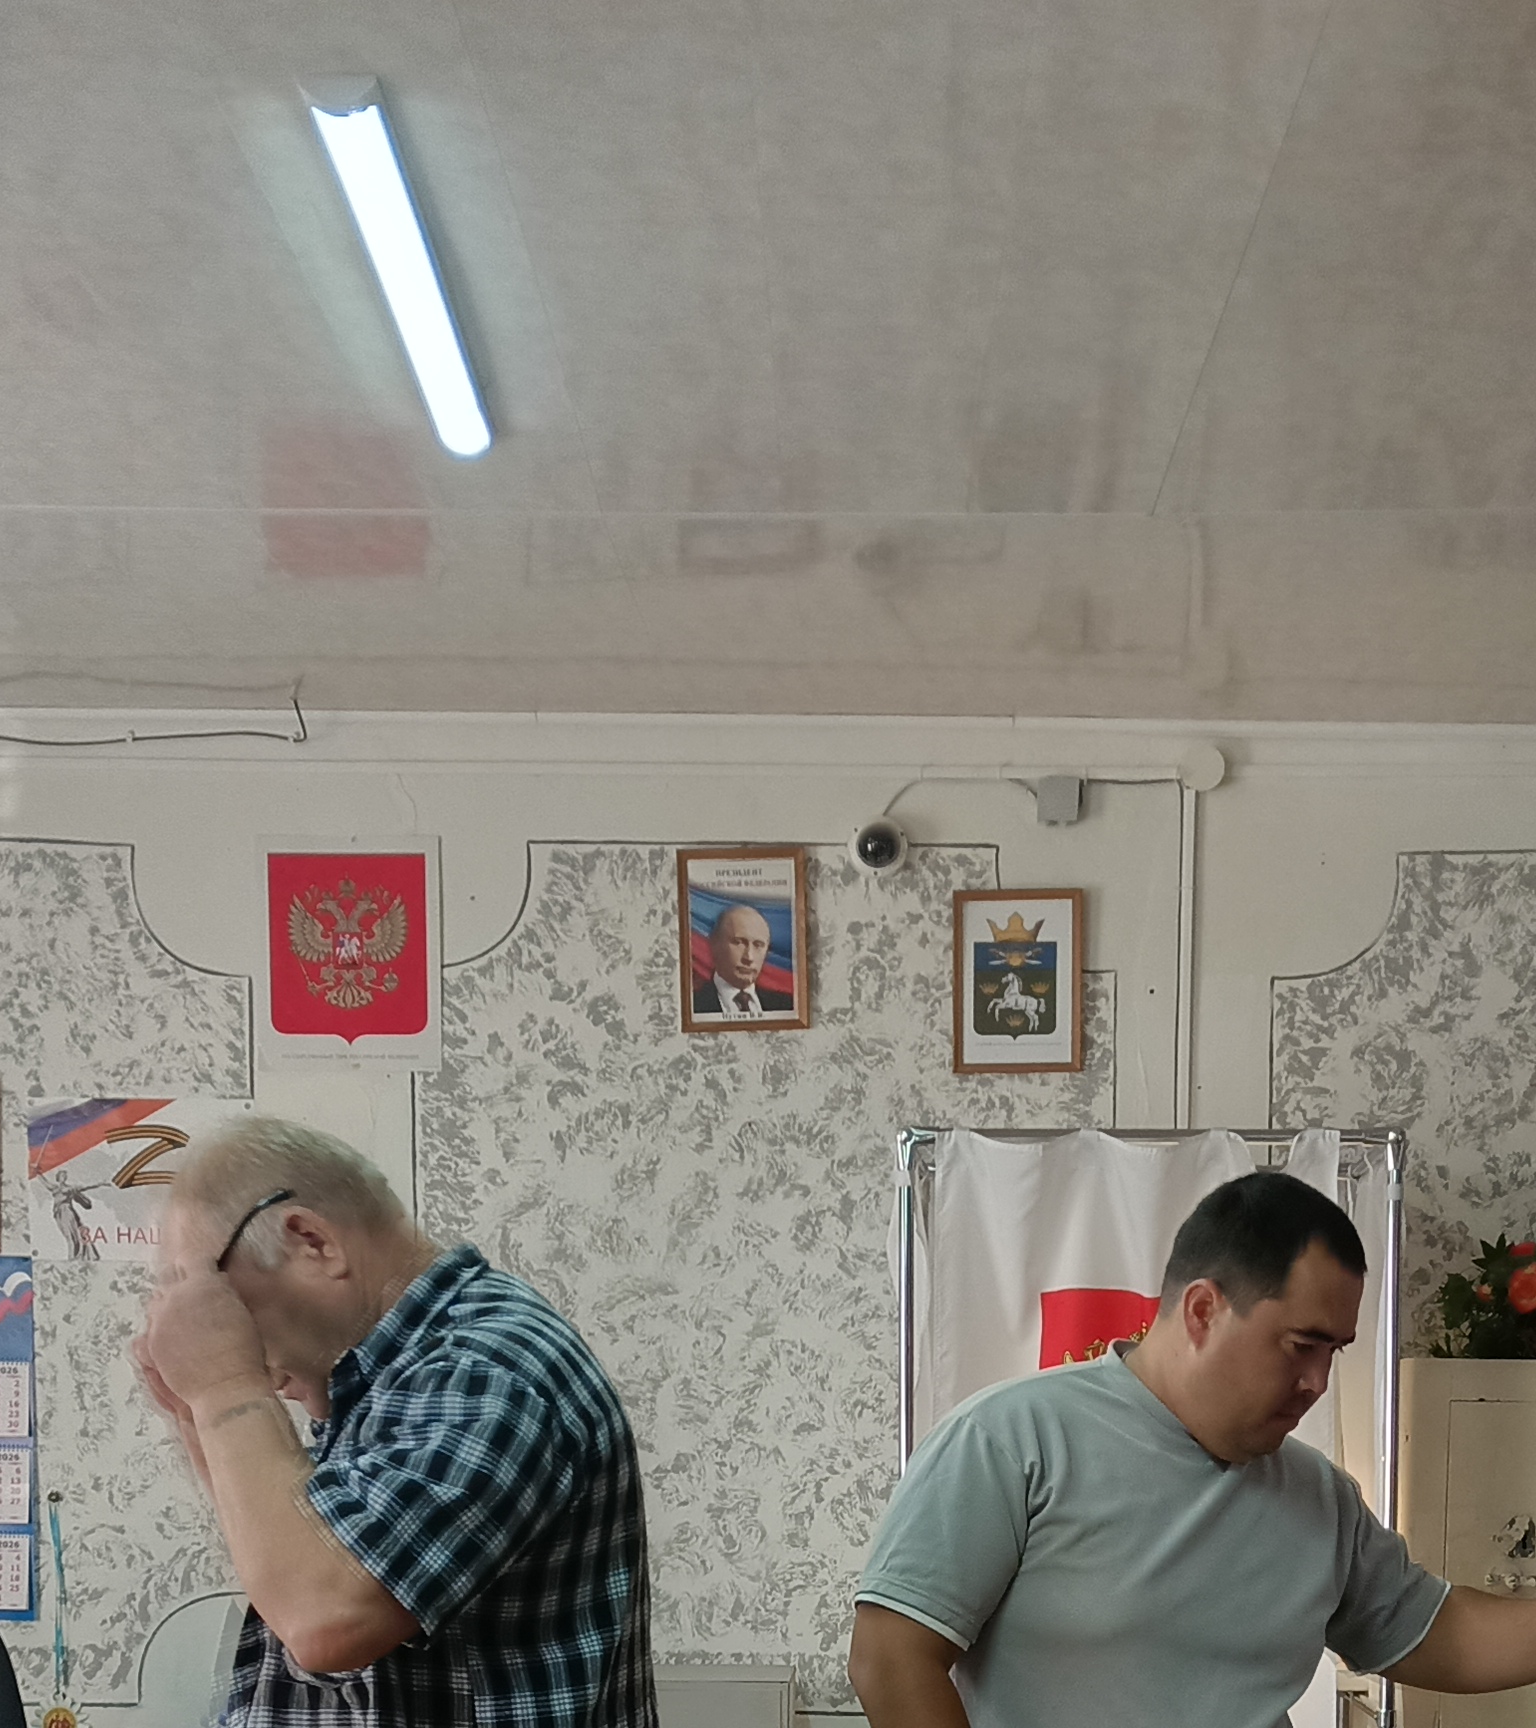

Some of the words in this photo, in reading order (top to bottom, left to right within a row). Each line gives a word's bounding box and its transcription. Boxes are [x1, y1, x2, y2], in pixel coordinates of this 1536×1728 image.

[79, 1226, 108, 1245] ЗА
[9, 1400, 20, 1408] 16
[8, 1410, 20, 1418] 23
[8, 1420, 19, 1428] 30
[10, 1487, 21, 1495] 20
[11, 1564, 20, 1572] 11
[10, 1574, 20, 1582] 18
[10, 1584, 20, 1592] 25
